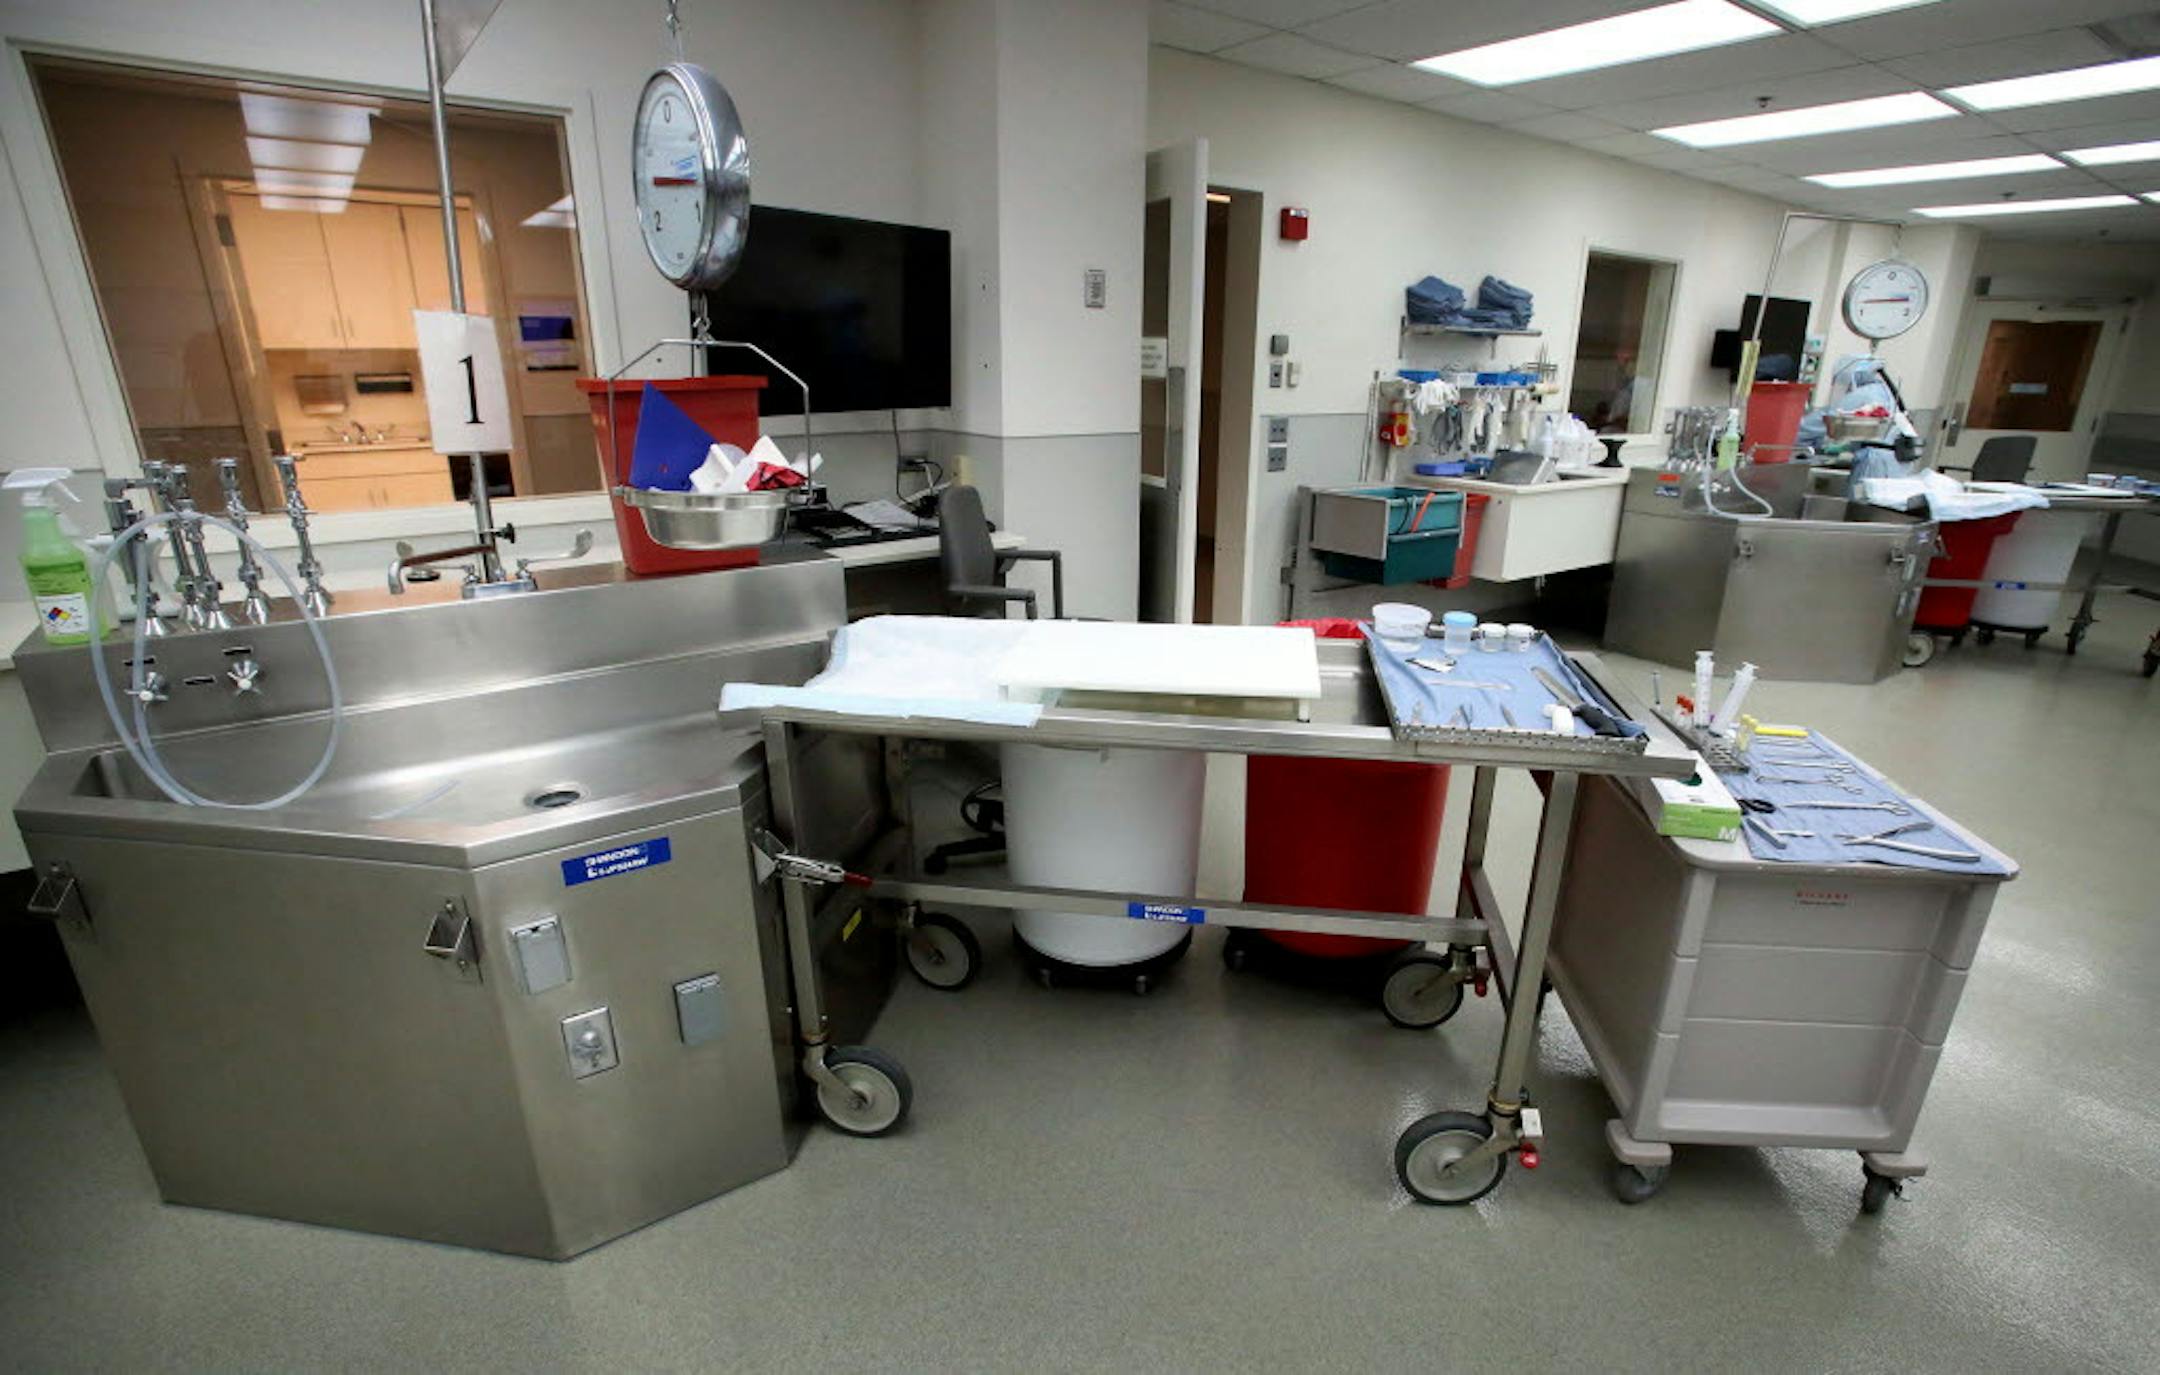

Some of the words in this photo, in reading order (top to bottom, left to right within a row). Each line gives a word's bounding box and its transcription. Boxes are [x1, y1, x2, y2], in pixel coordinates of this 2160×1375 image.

[663, 100, 672, 124] 0
[654, 209, 662, 232] 2
[1887, 271, 1897, 281] 0
[458, 354, 485, 425] 1
[1718, 826, 1737, 841] M
